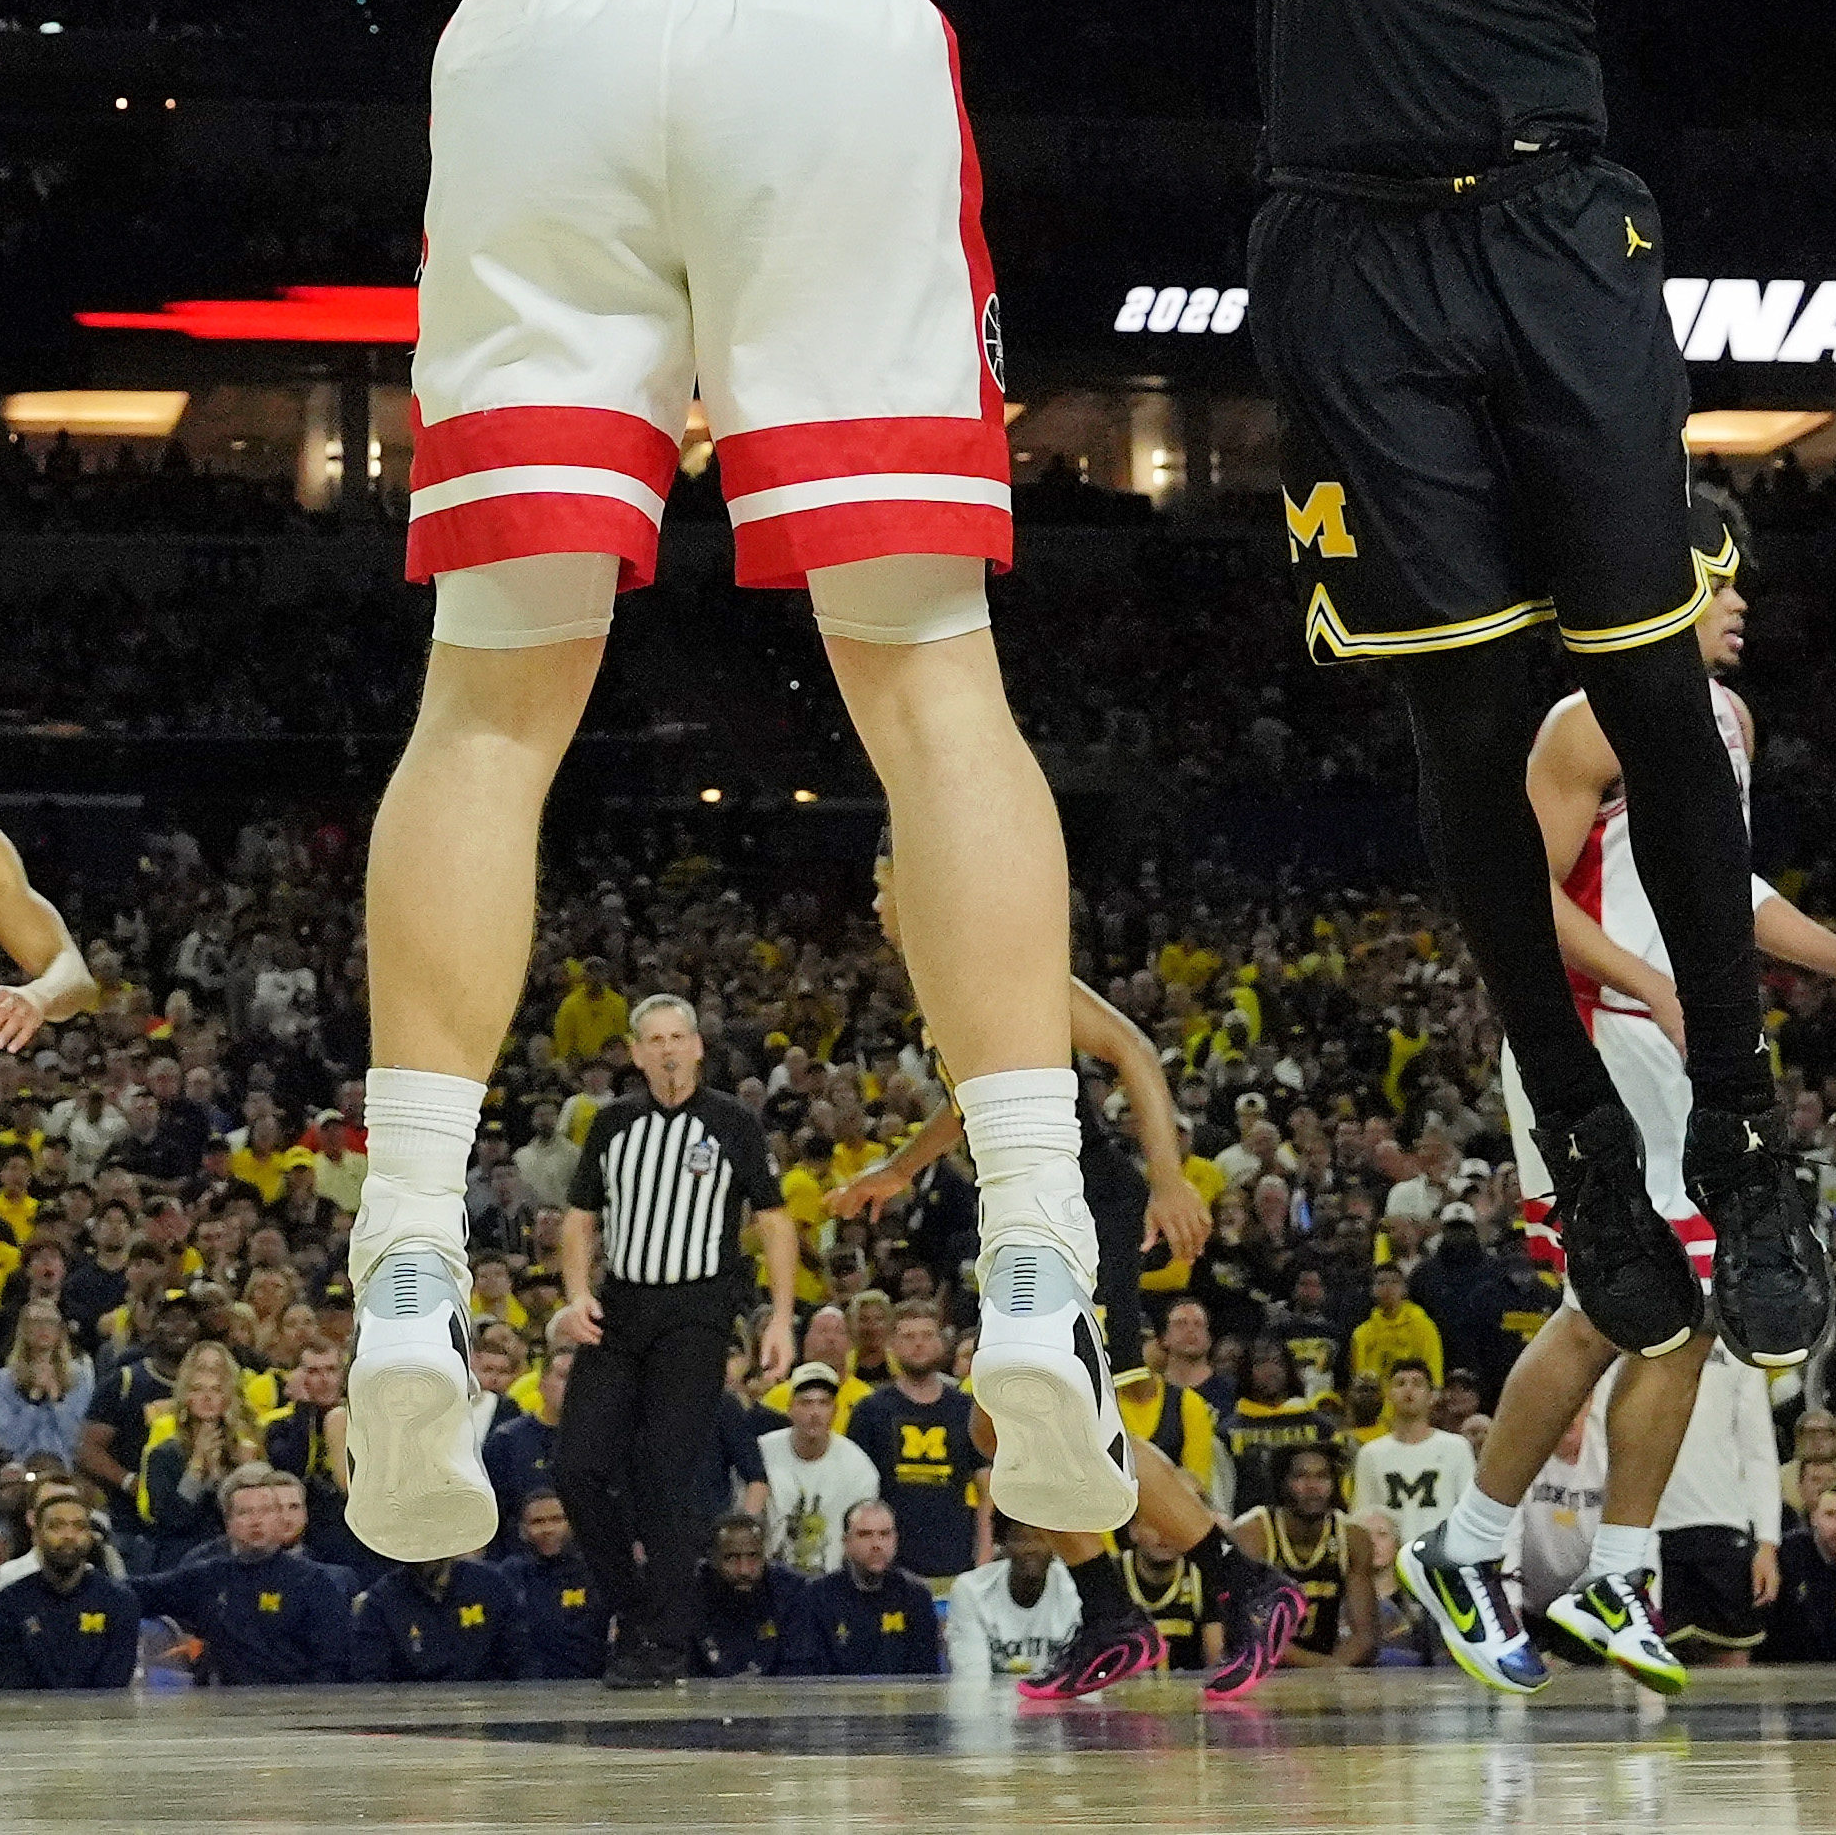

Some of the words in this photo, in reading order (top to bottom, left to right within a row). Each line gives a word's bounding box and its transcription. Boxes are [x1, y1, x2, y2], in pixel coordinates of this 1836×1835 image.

[1113, 284, 1251, 335] 2026
[900, 1424, 948, 1460] M
[1384, 1469, 1441, 1510] M
